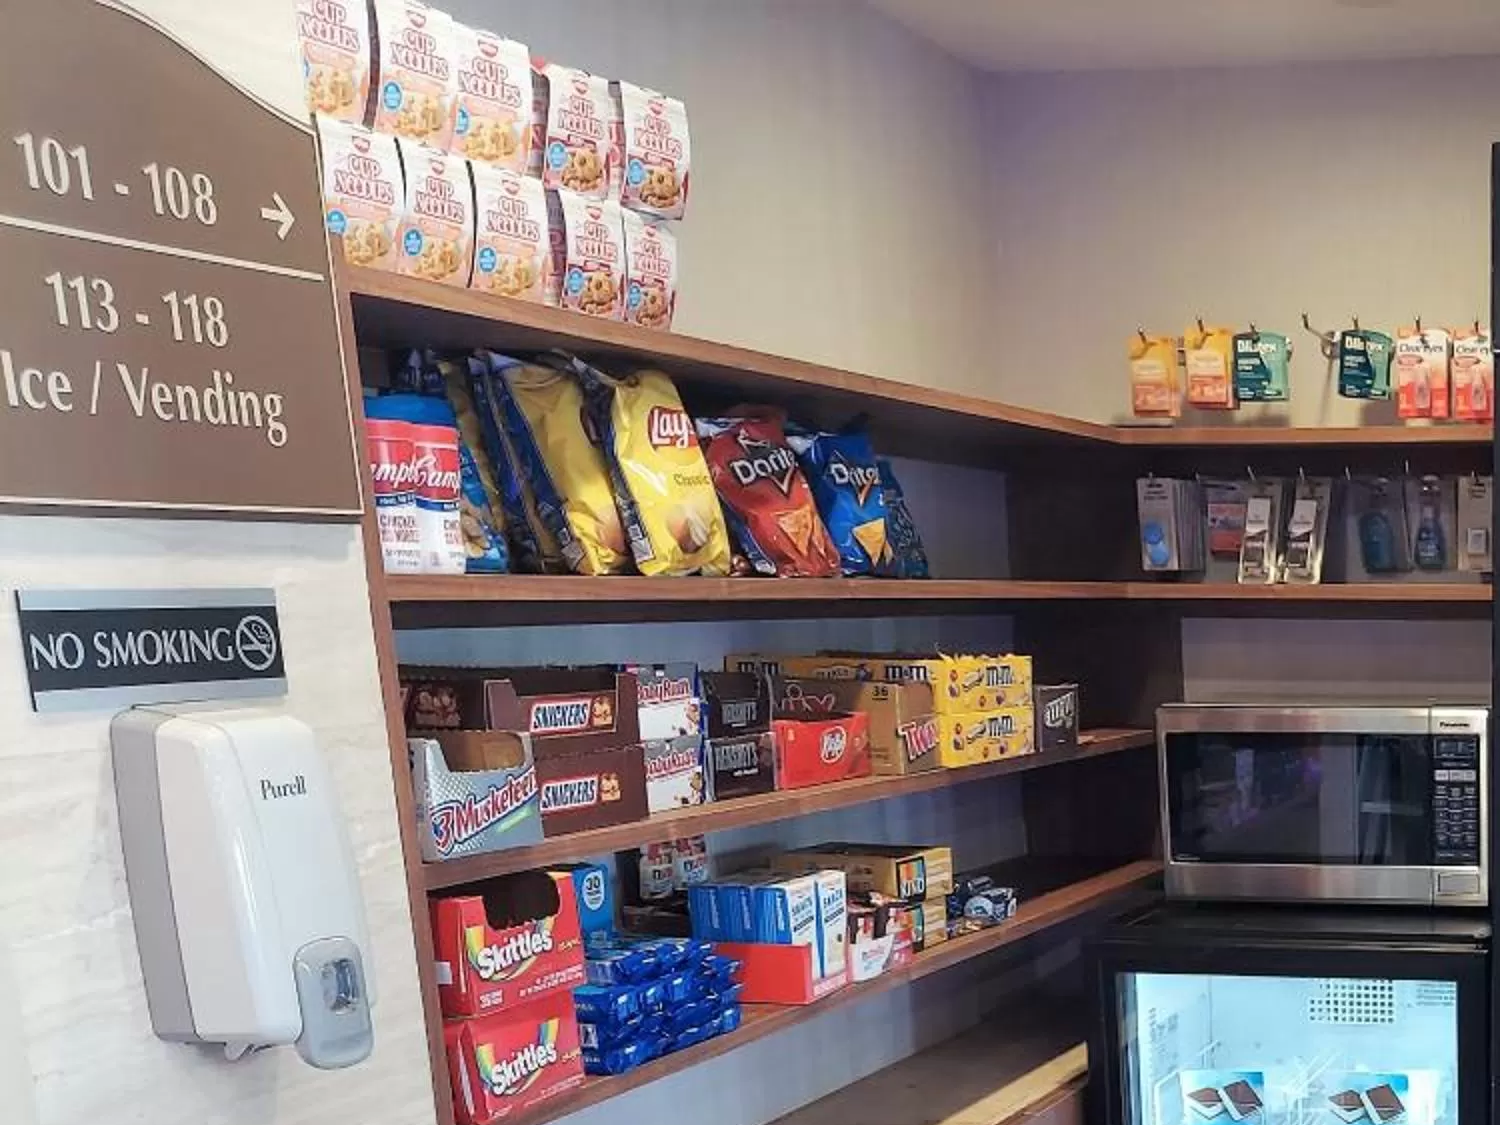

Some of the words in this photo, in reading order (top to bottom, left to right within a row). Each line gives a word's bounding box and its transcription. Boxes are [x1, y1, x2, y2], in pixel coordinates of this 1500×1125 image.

[403, 28, 436, 50] CUP
[472, 56, 508, 81] CUP
[14, 132, 93, 200] 101
[142, 162, 218, 226] 108
[349, 154, 382, 179] CUP
[426, 176, 454, 198] CUP
[45, 271, 120, 334] 113
[163, 290, 229, 348] 118
[1, 351, 73, 413] Ice
[91, 360, 102, 415] /
[117, 363, 288, 447] Vending
[29, 633, 85, 670] NO
[94, 628, 236, 667] SMOKING
[534, 703, 587, 729] SNICKERS
[260, 775, 307, 800] Purell
[542, 779, 596, 809] SNICKERS
[432, 808, 455, 852] 3
[901, 878, 925, 896] KIND
[478, 930, 553, 980] Skittles
[492, 1043, 557, 1096] Skittles
